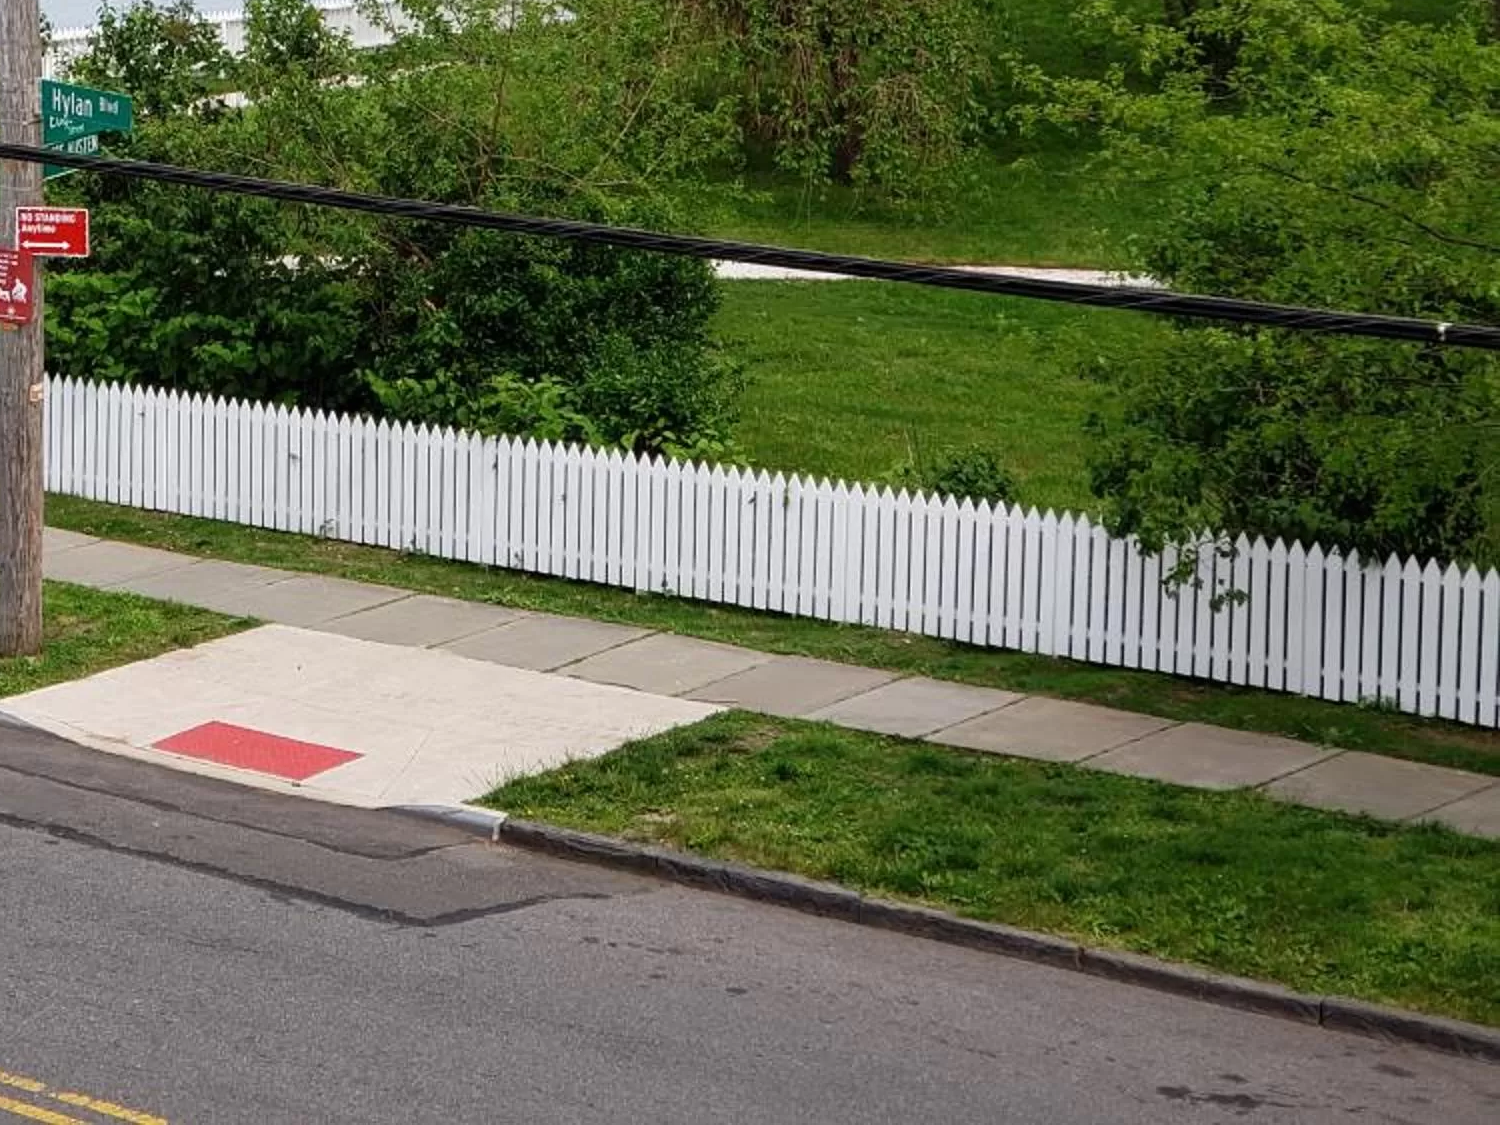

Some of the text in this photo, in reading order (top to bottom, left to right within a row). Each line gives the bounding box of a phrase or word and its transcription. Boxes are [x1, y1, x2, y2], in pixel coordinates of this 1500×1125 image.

[52, 87, 93, 119] Hylan
[20, 213, 76, 224] NO STANDING
